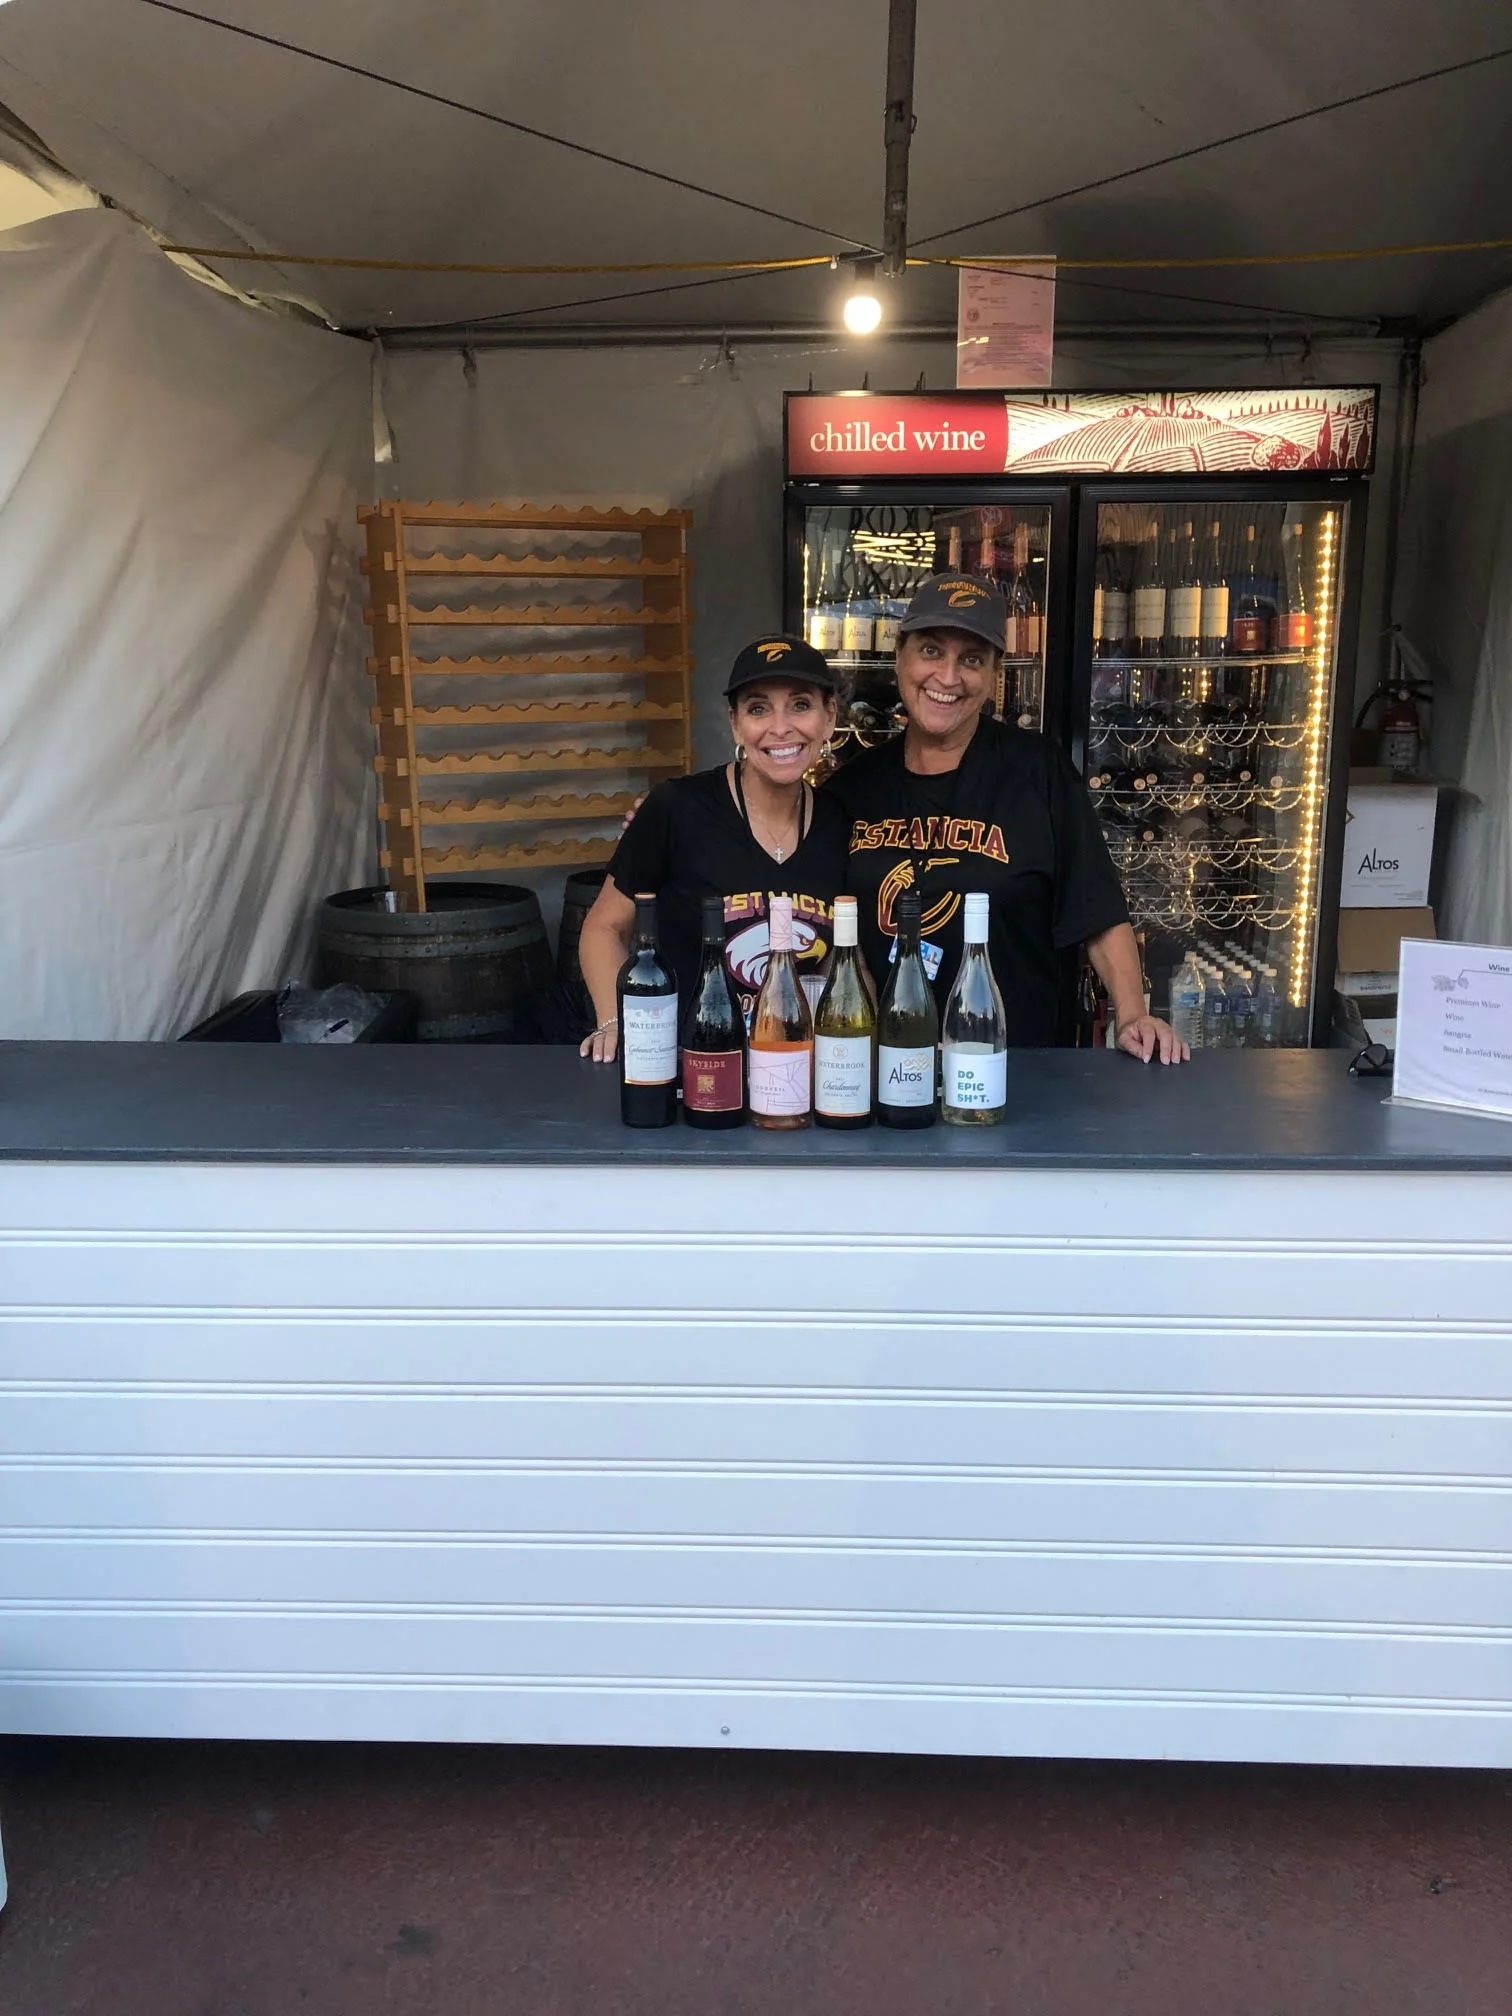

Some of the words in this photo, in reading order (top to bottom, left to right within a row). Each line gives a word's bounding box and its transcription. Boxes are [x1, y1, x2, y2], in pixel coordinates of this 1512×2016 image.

[810, 421, 906, 452] chilled
[912, 421, 986, 451] wine
[1488, 963, 1511, 973] Wine
[957, 1070, 974, 1080] DO
[957, 1082, 985, 1092] EPIC
